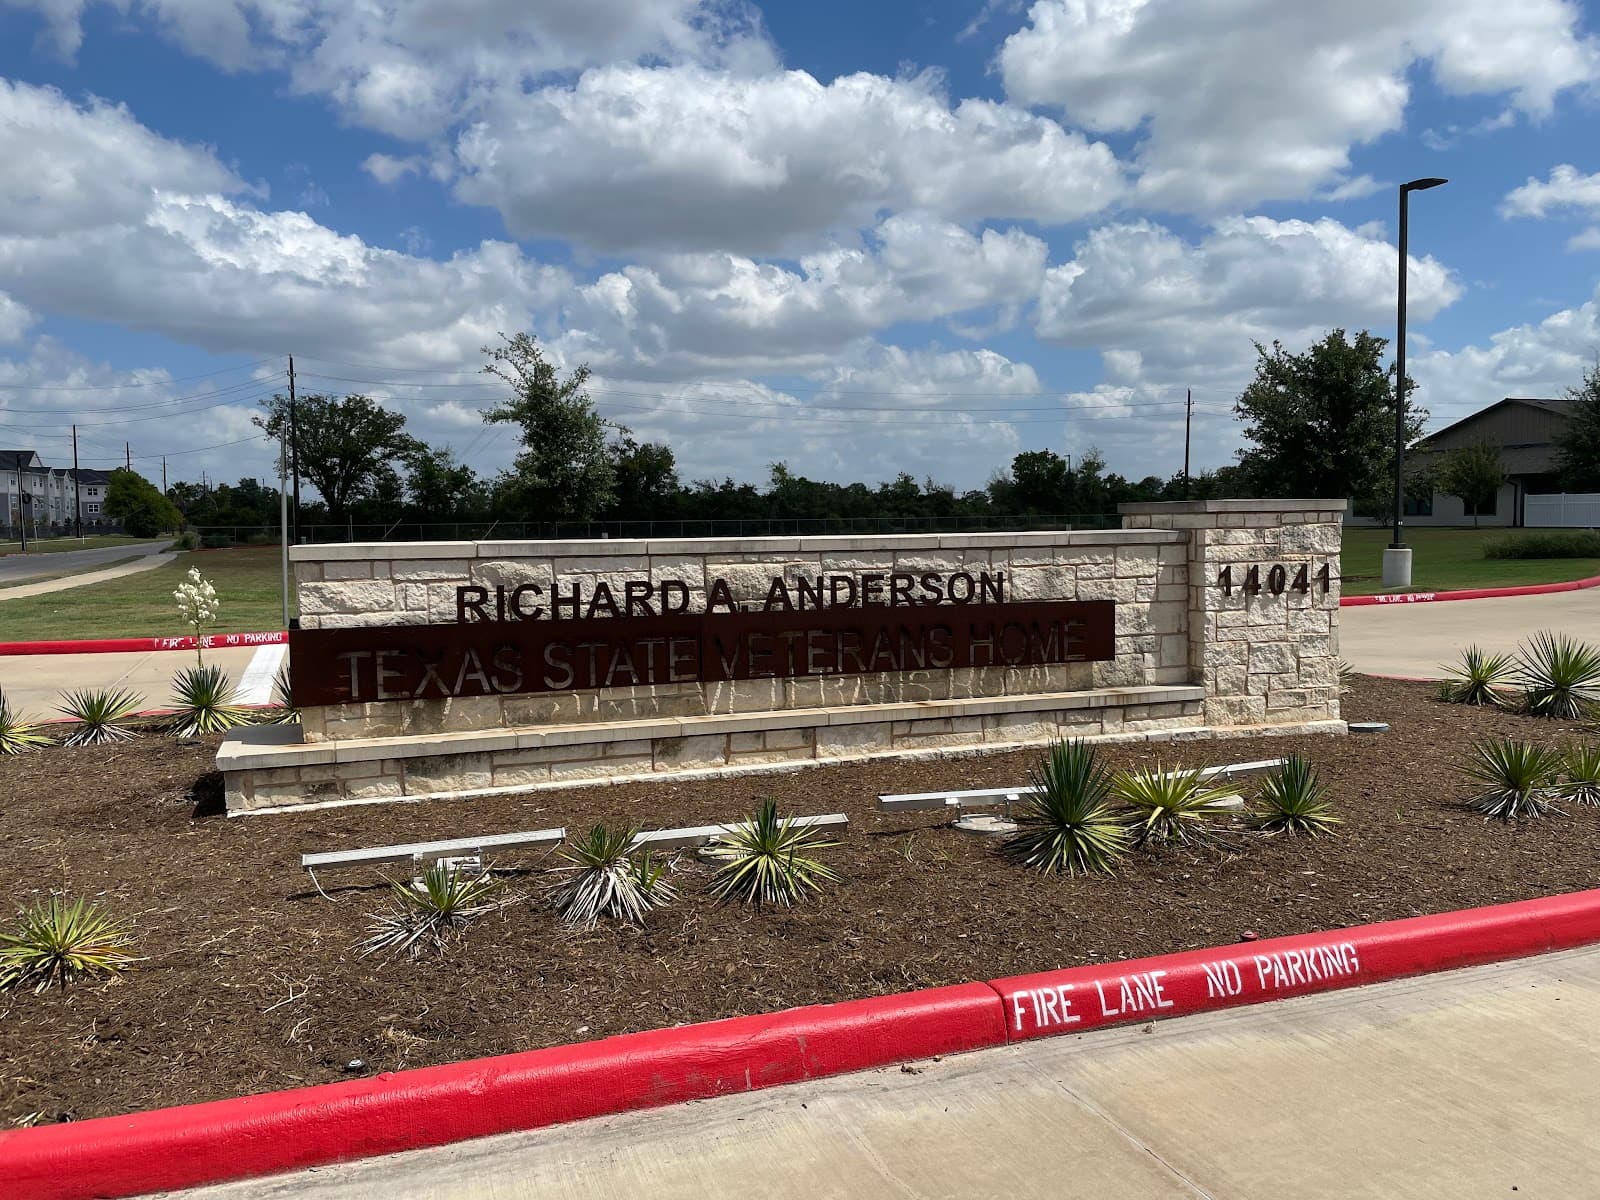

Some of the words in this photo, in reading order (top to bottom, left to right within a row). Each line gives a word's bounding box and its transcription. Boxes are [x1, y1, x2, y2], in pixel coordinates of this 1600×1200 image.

[456, 579, 690, 624] RICHARD
[705, 578, 749, 614] A.
[764, 572, 1004, 612] ANDERSON
[1218, 562, 1331, 597] 14041
[189, 635, 215, 648] LNE
[226, 634, 240, 644] NO
[244, 632, 282, 643] PARKING
[336, 644, 524, 700] TEXAS
[543, 637, 698, 691] STATE
[714, 626, 955, 679] VETERANS
[969, 618, 1088, 666] HOME
[1013, 983, 1081, 1031] FIRE
[1094, 970, 1174, 1017] LANE
[1202, 959, 1242, 999] NO
[1253, 942, 1360, 990] PARKING
